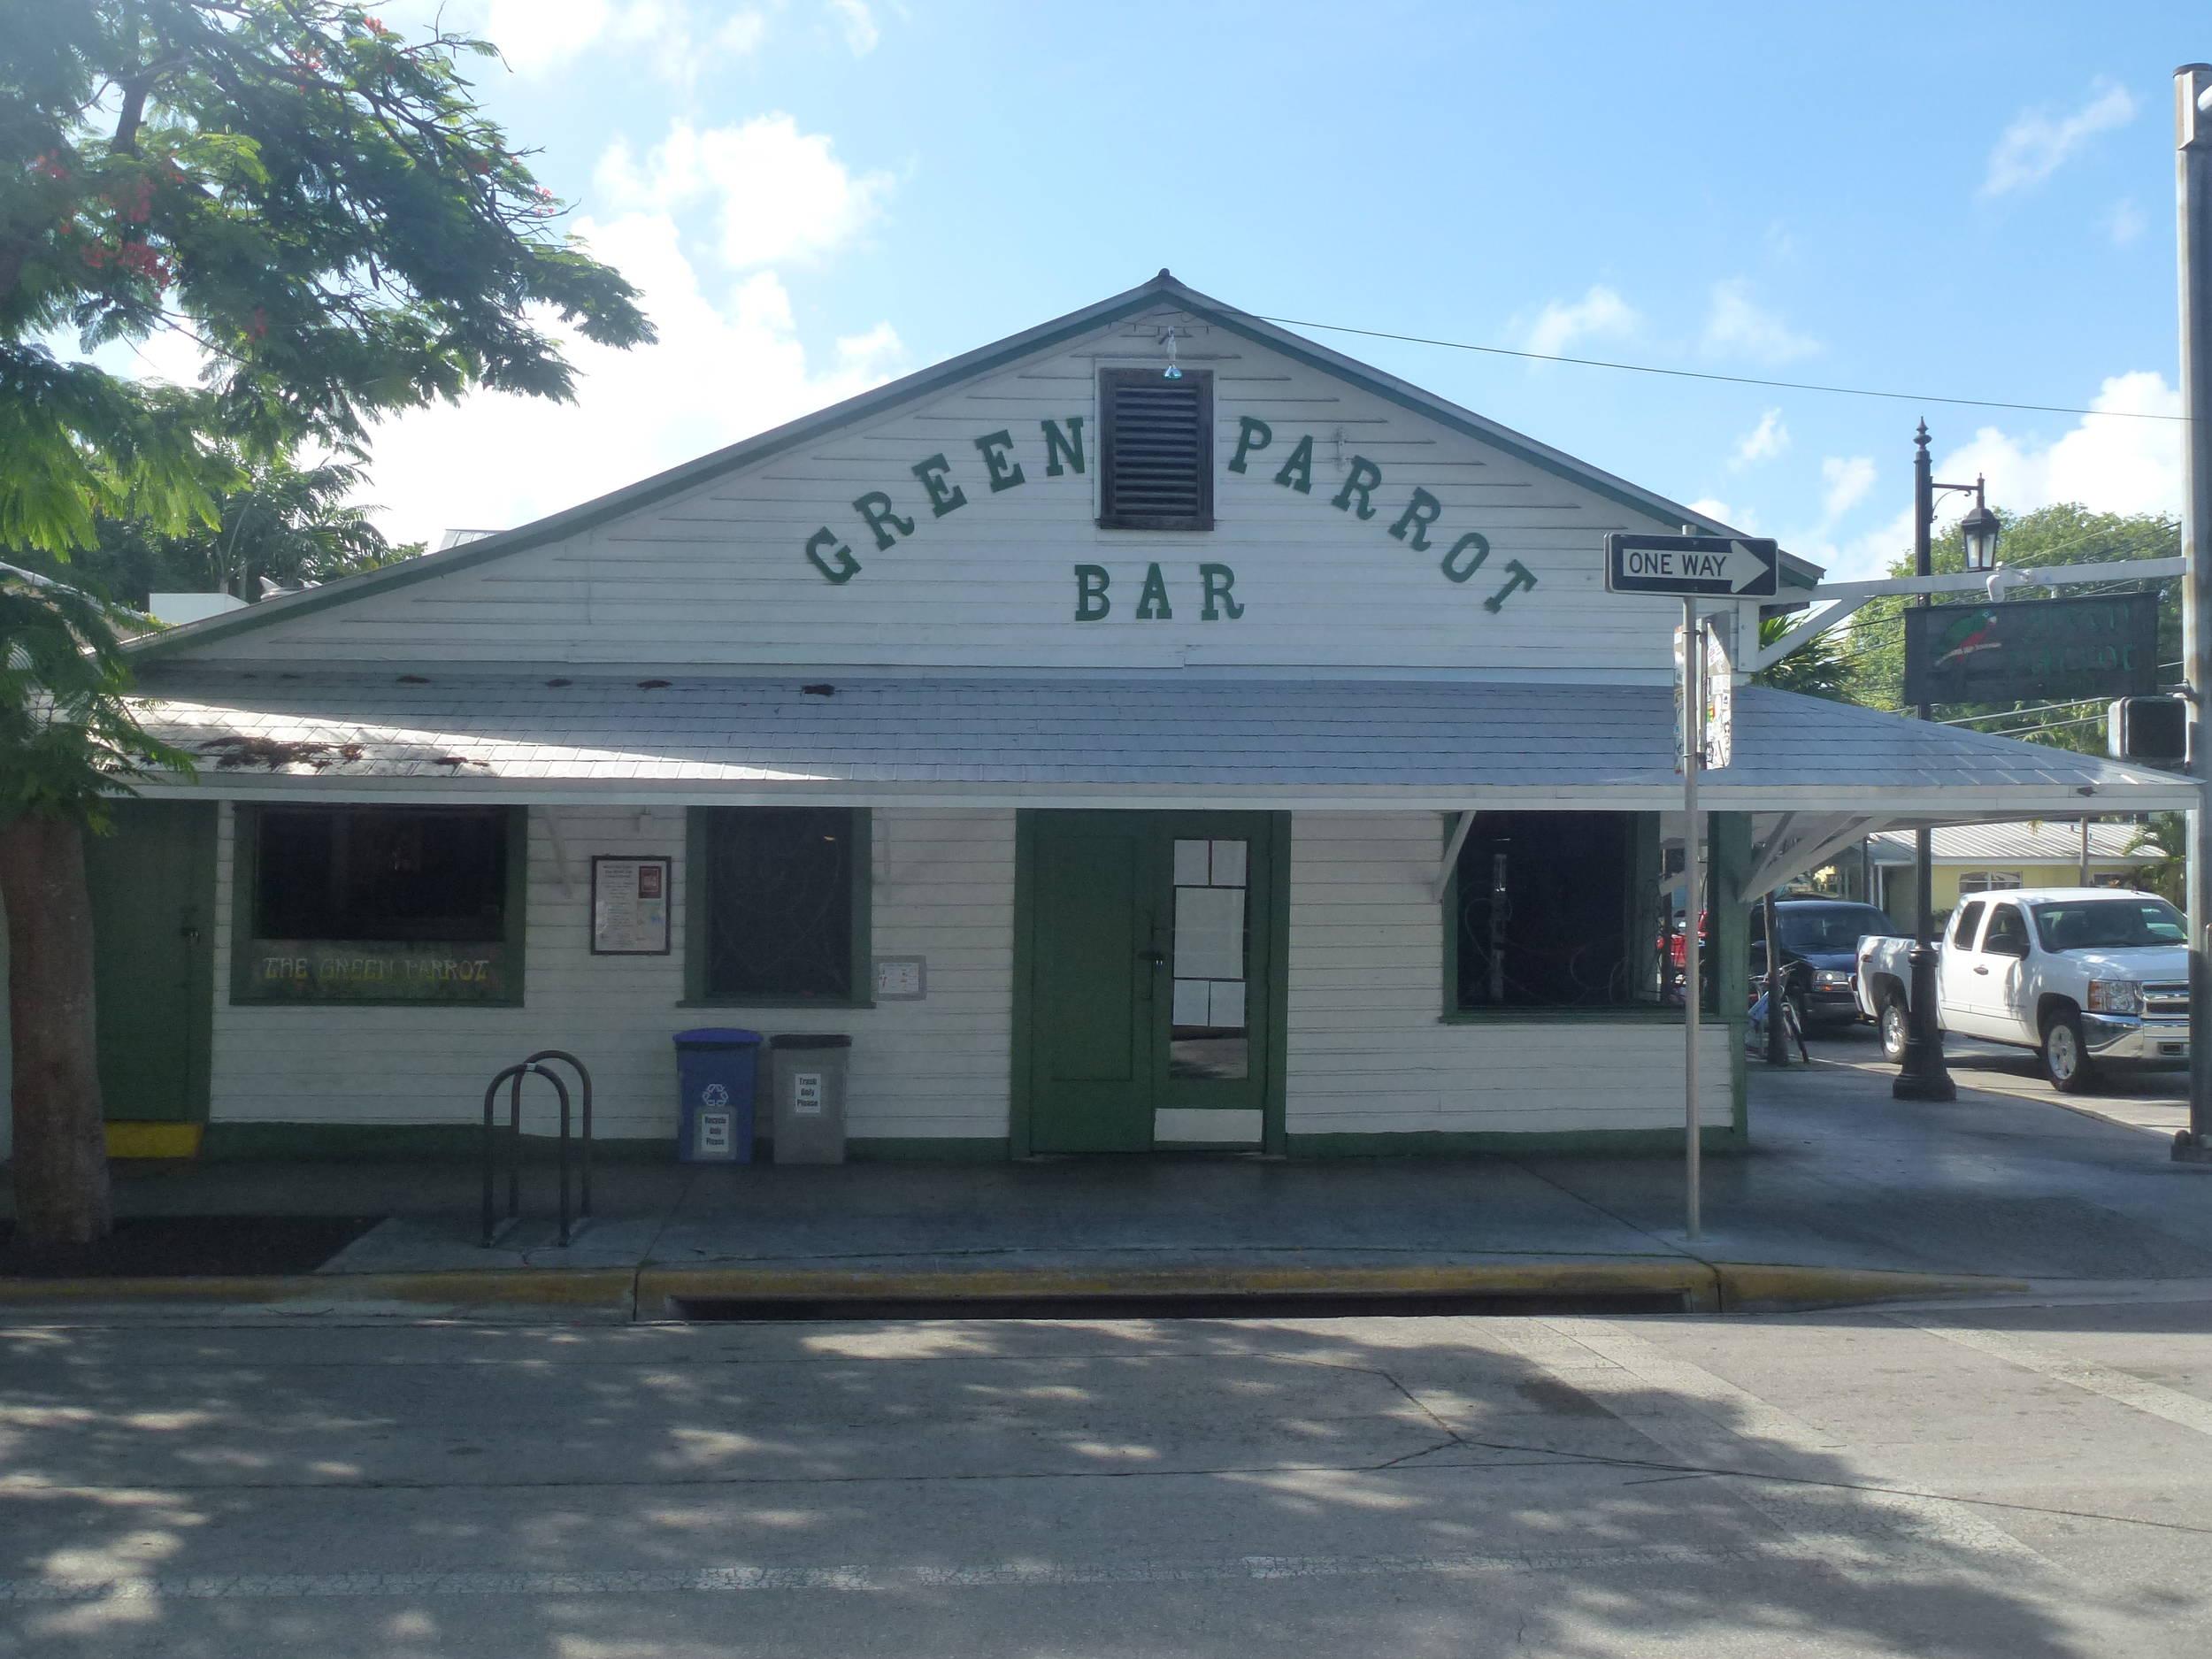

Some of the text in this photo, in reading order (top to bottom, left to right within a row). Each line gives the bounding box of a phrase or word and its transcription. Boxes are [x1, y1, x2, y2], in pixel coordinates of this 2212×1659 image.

[804, 416, 1538, 614] GREEN PARROT
[1629, 552, 1727, 577] ONE WAY
[1073, 563, 1245, 622] BAR
[262, 957, 309, 979] THE
